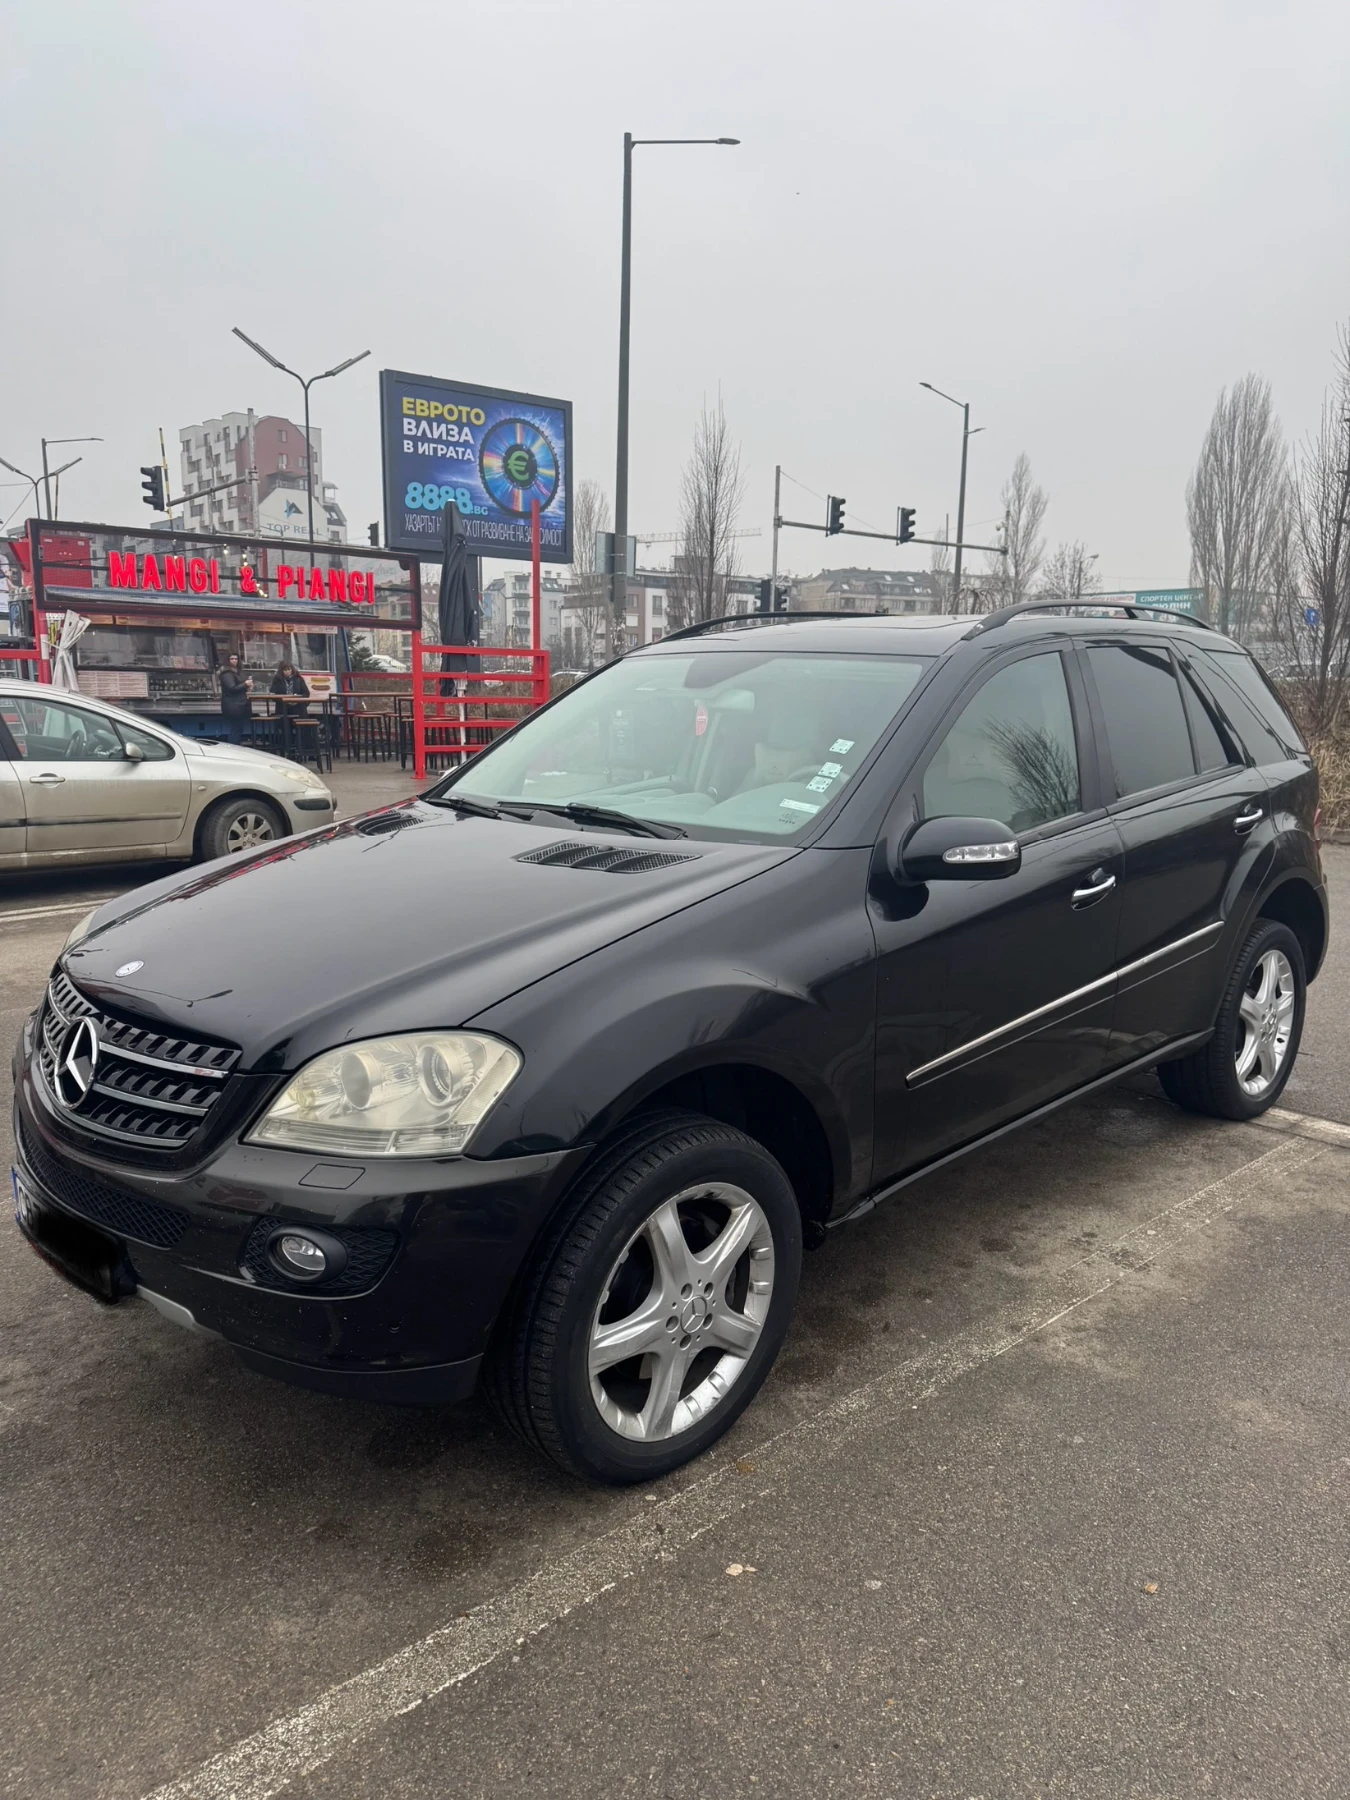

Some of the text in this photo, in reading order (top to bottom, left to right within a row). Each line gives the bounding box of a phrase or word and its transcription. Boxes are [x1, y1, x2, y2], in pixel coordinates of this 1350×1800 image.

[402, 397, 485, 426] ЕВРОТО
[403, 417, 474, 445] ВЛИЗА
[404, 440, 475, 462] В ИГРАТА
[266, 523, 322, 536] TOP REL
[405, 513, 436, 533] ХАЗАРТЪТ
[524, 526, 562, 546] ЗАСИМОСТ
[108, 550, 375, 604] MANGI & PIANGI
